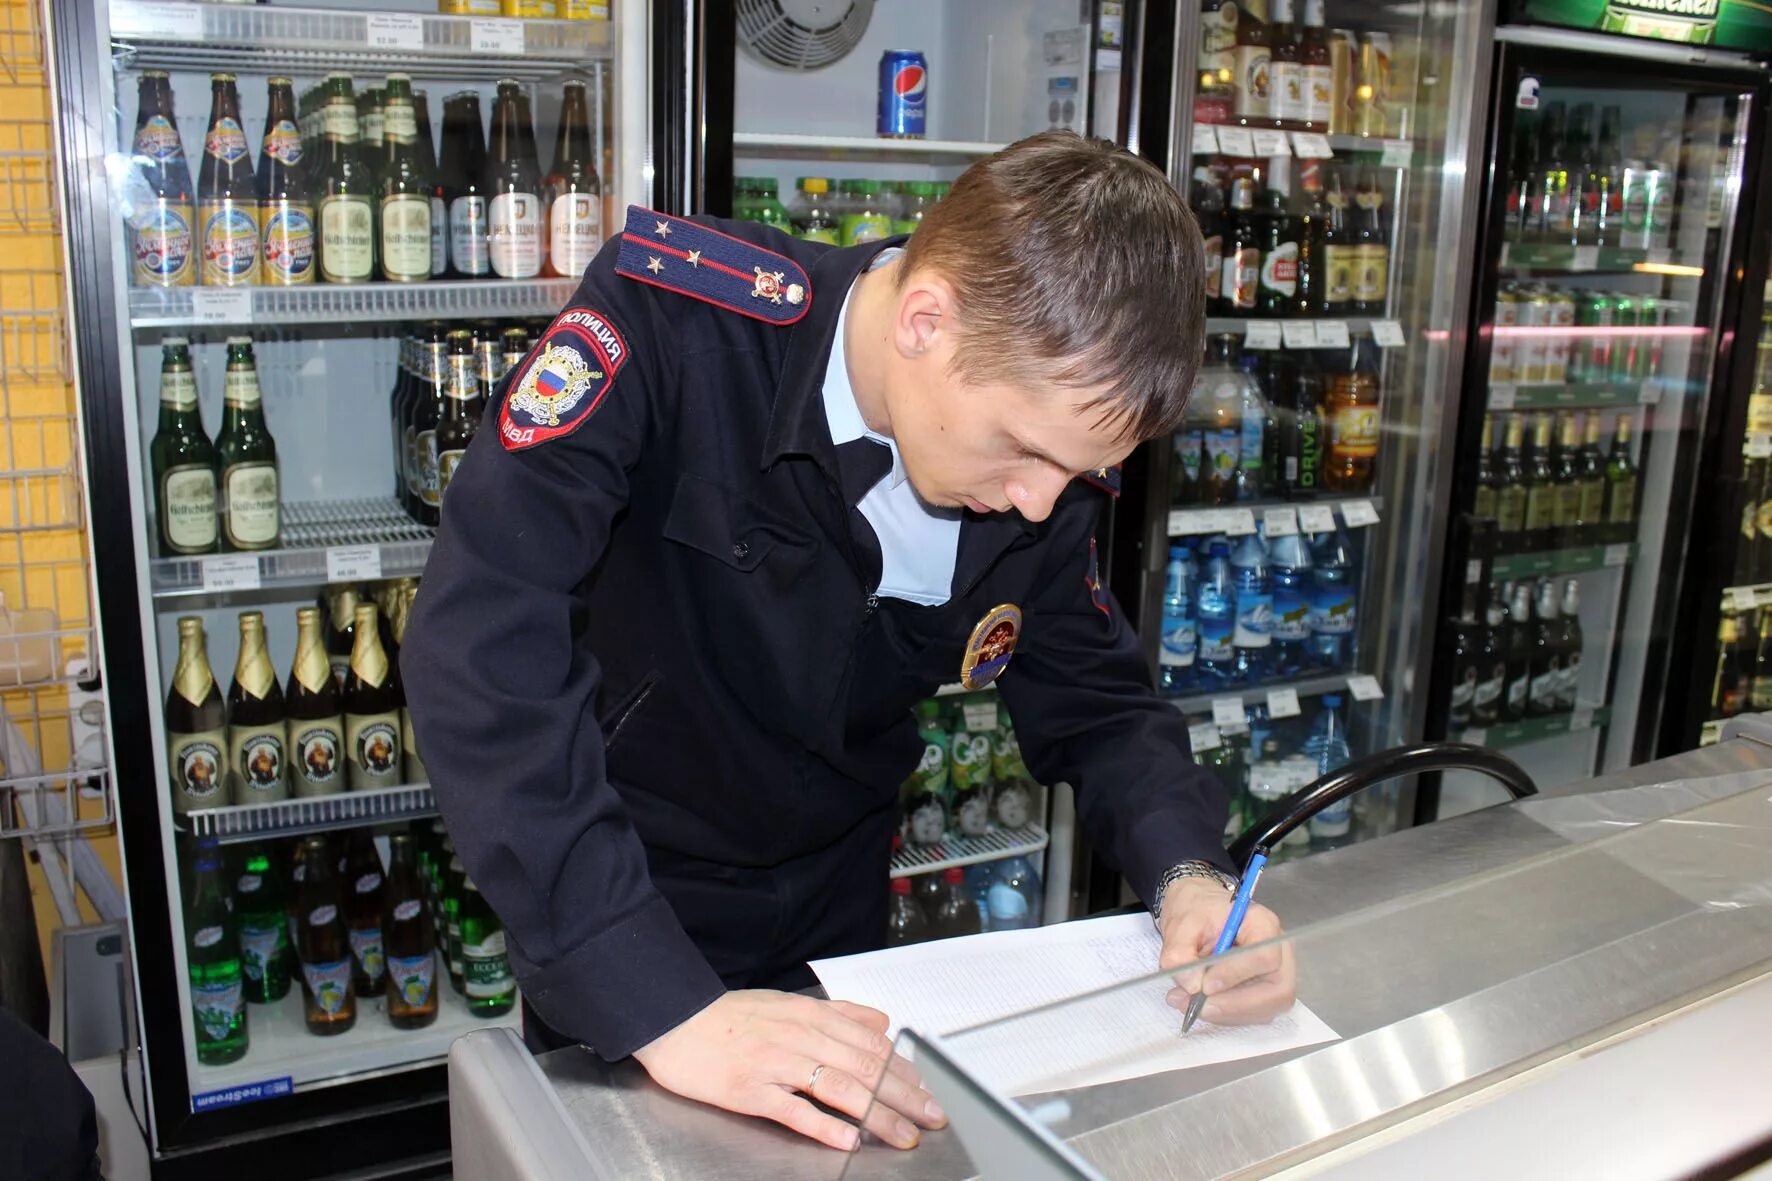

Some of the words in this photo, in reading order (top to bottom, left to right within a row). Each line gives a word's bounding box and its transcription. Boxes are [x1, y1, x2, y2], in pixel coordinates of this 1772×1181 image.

[557, 312, 621, 362] ПОЛИЦИЯ
[502, 417, 535, 444] МВД
[1302, 420, 1315, 487] DRIVE
